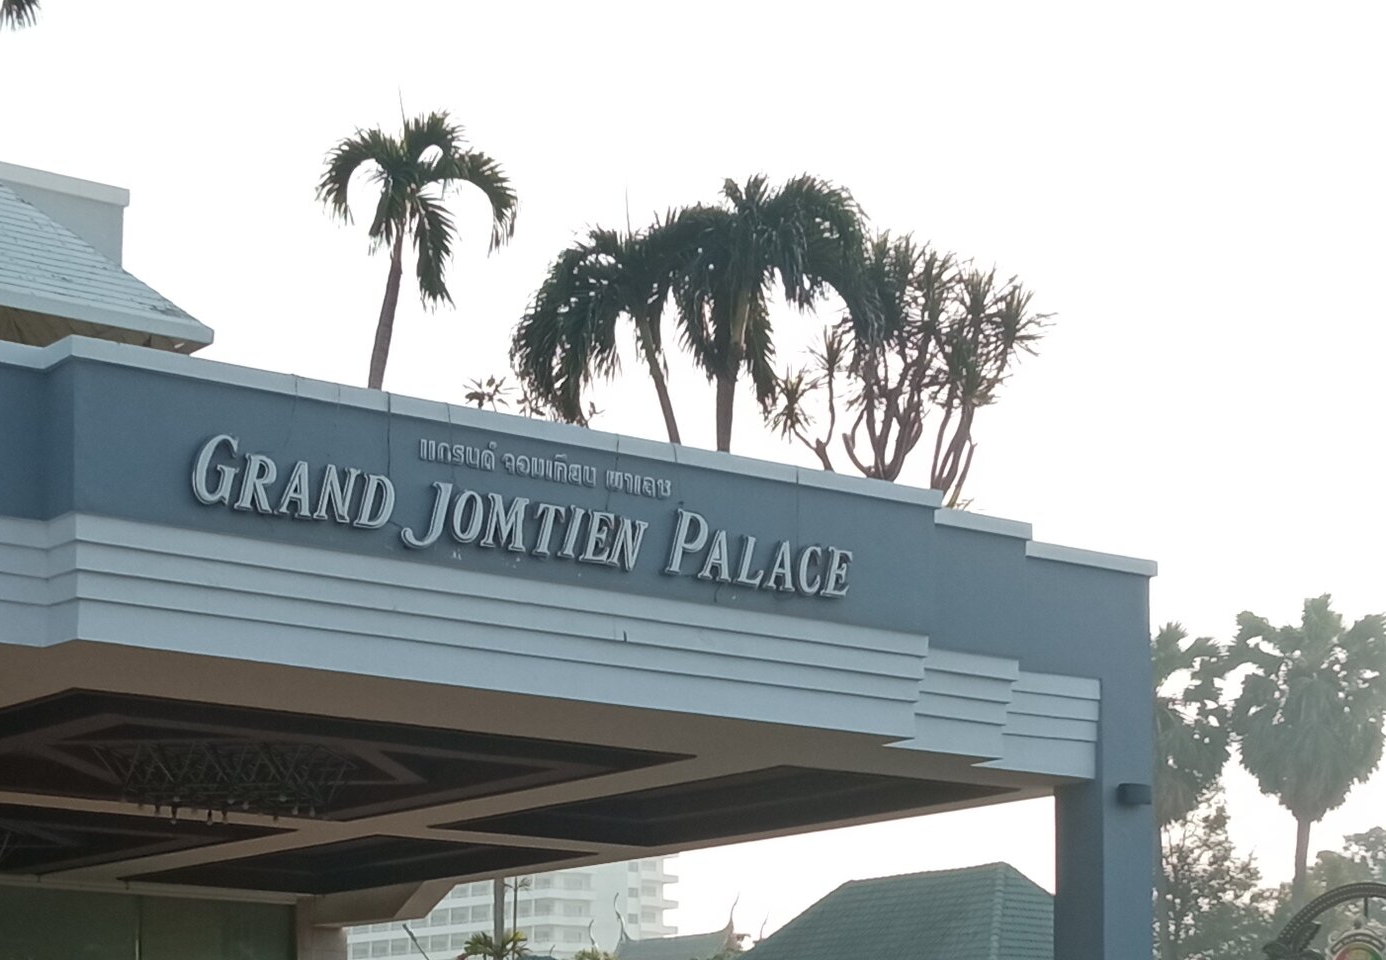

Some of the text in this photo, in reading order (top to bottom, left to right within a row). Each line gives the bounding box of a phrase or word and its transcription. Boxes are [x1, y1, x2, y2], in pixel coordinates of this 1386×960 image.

[419, 438, 497, 471] แกรนด์
[501, 453, 598, 487] จอมเทียน
[192, 434, 853, 598] GRAND JOMTIEN PALACE
